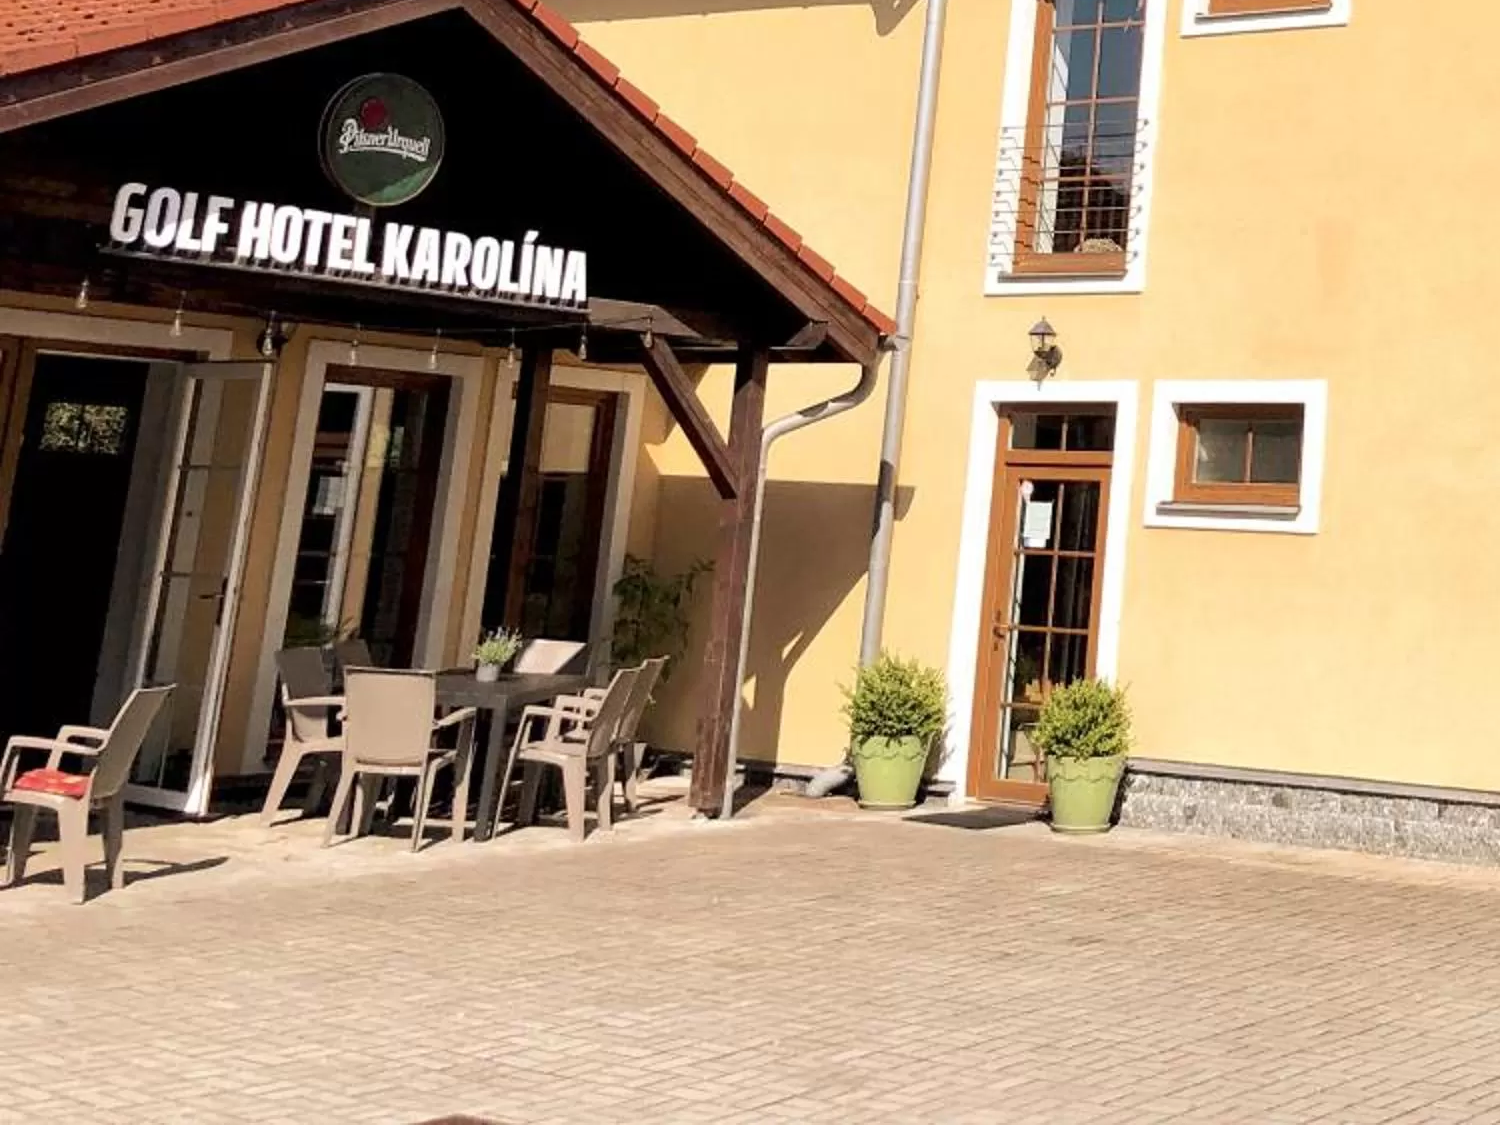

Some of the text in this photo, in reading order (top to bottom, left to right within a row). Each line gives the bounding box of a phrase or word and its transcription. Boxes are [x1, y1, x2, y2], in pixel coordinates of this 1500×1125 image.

[109, 182, 589, 303] GOLF HOTEL KAROLÍNA
